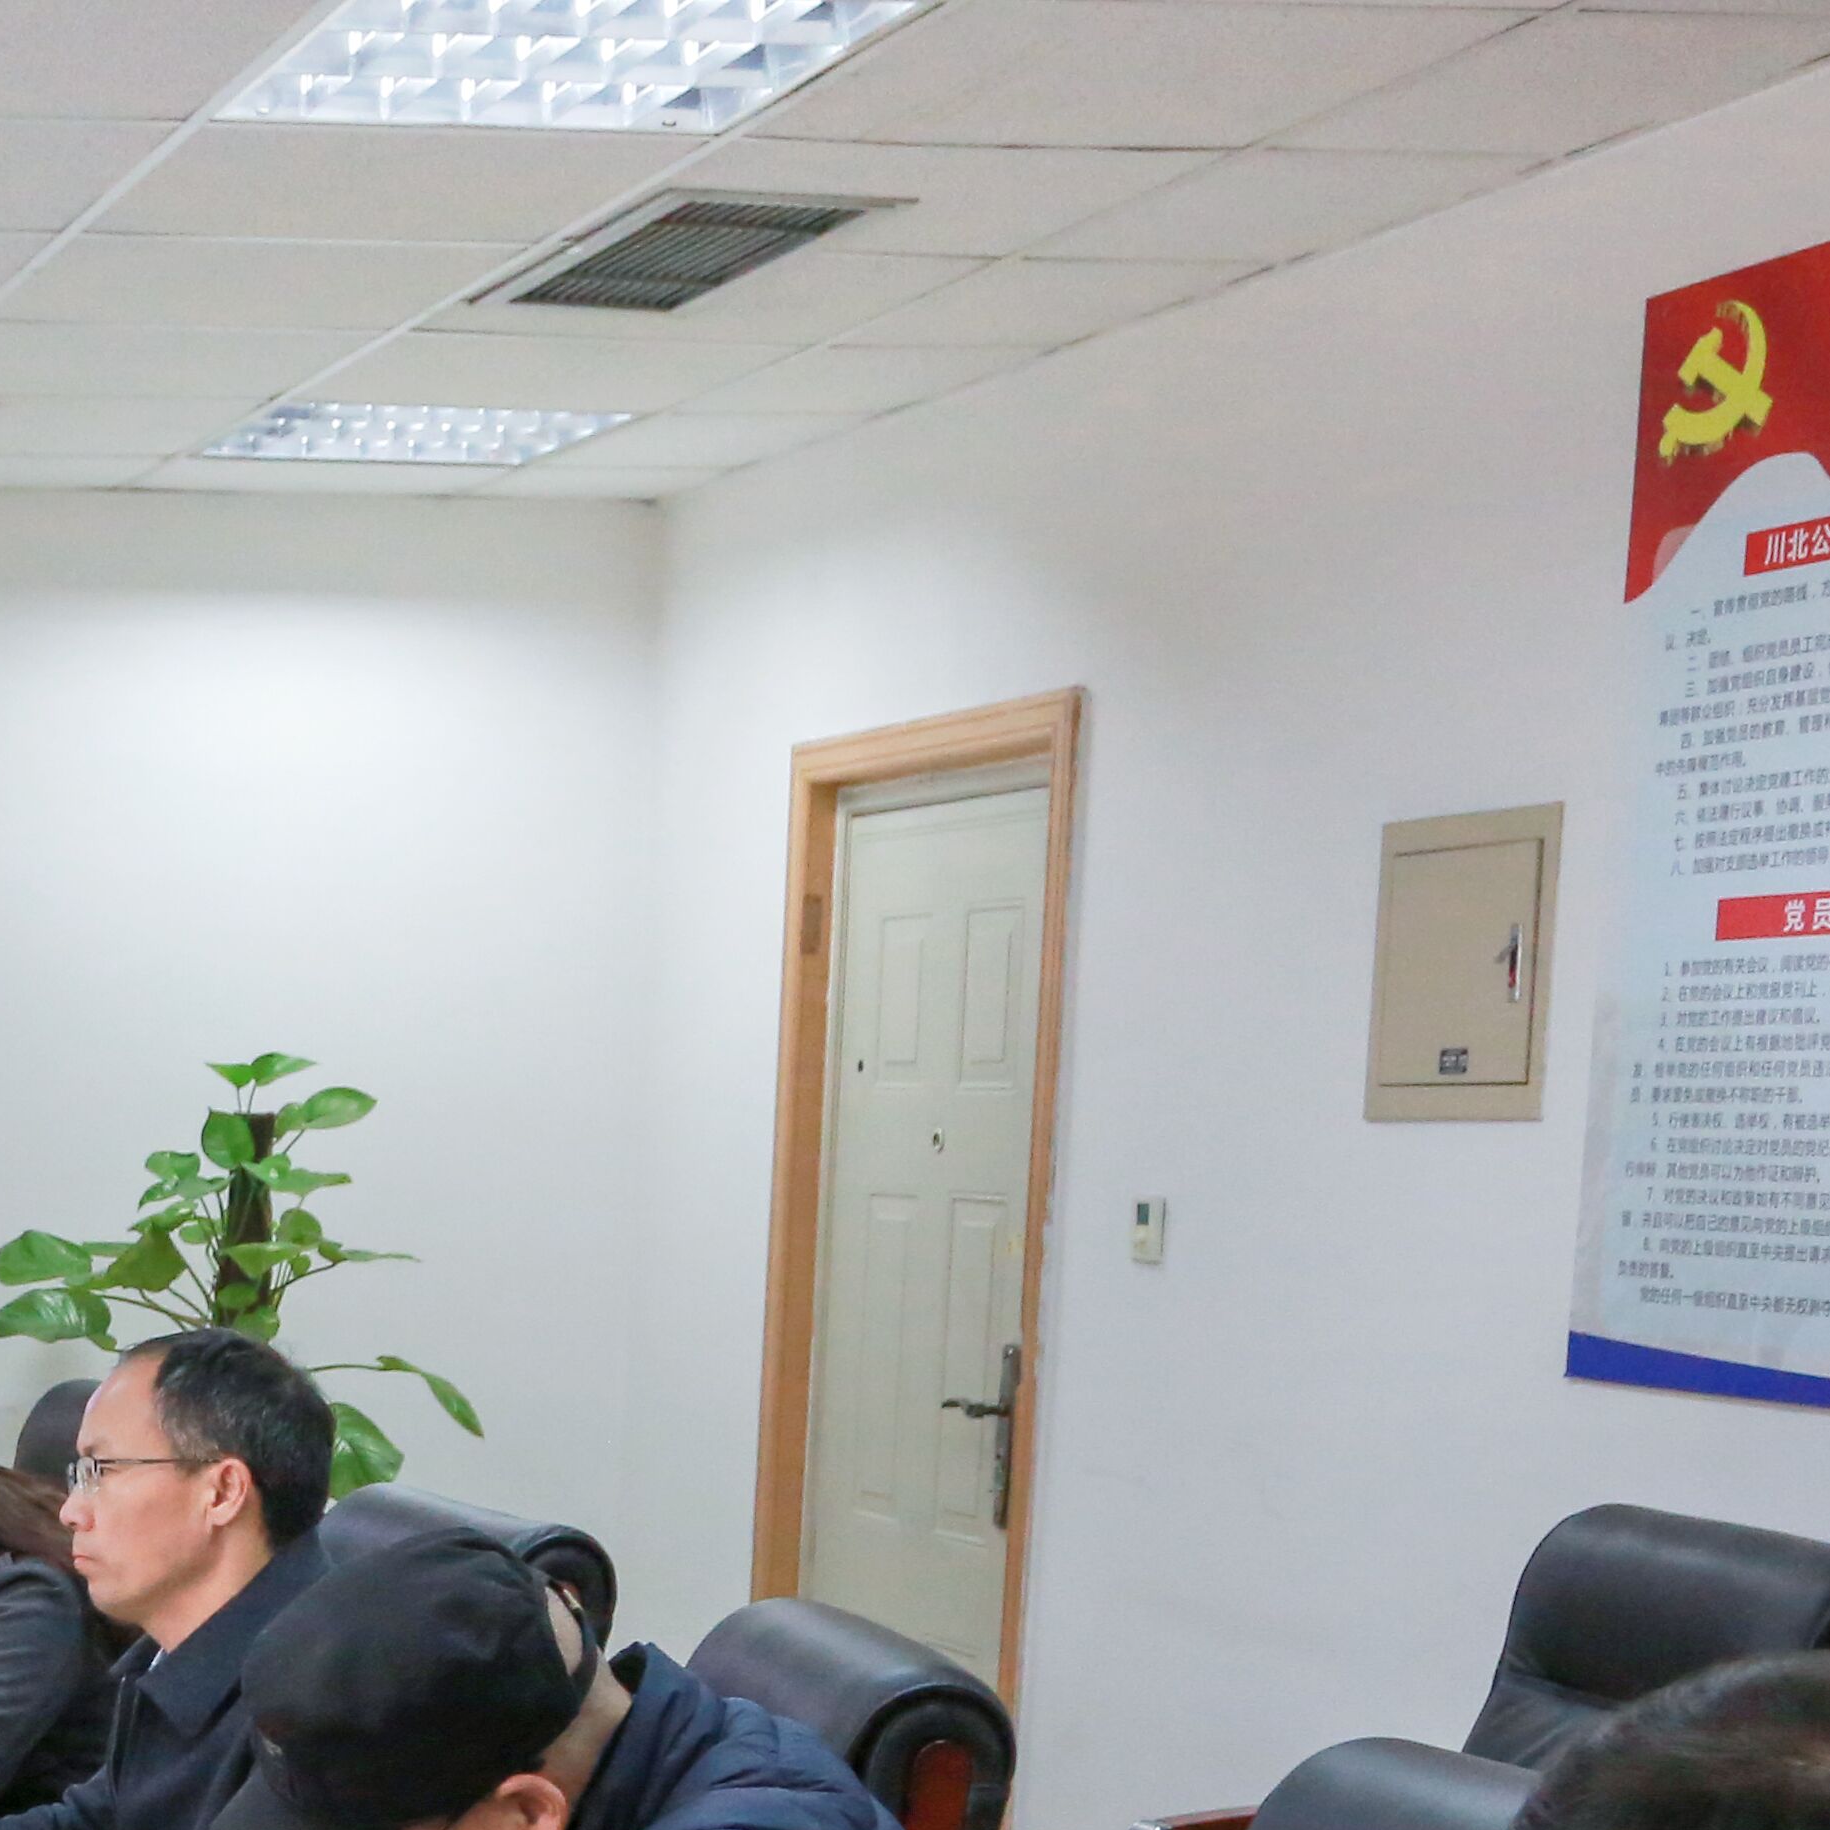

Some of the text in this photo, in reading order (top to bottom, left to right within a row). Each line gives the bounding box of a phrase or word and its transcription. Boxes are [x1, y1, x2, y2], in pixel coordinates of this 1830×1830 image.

[1764, 523, 1830, 566] 川北公
[1782, 898, 1830, 933] 党员
